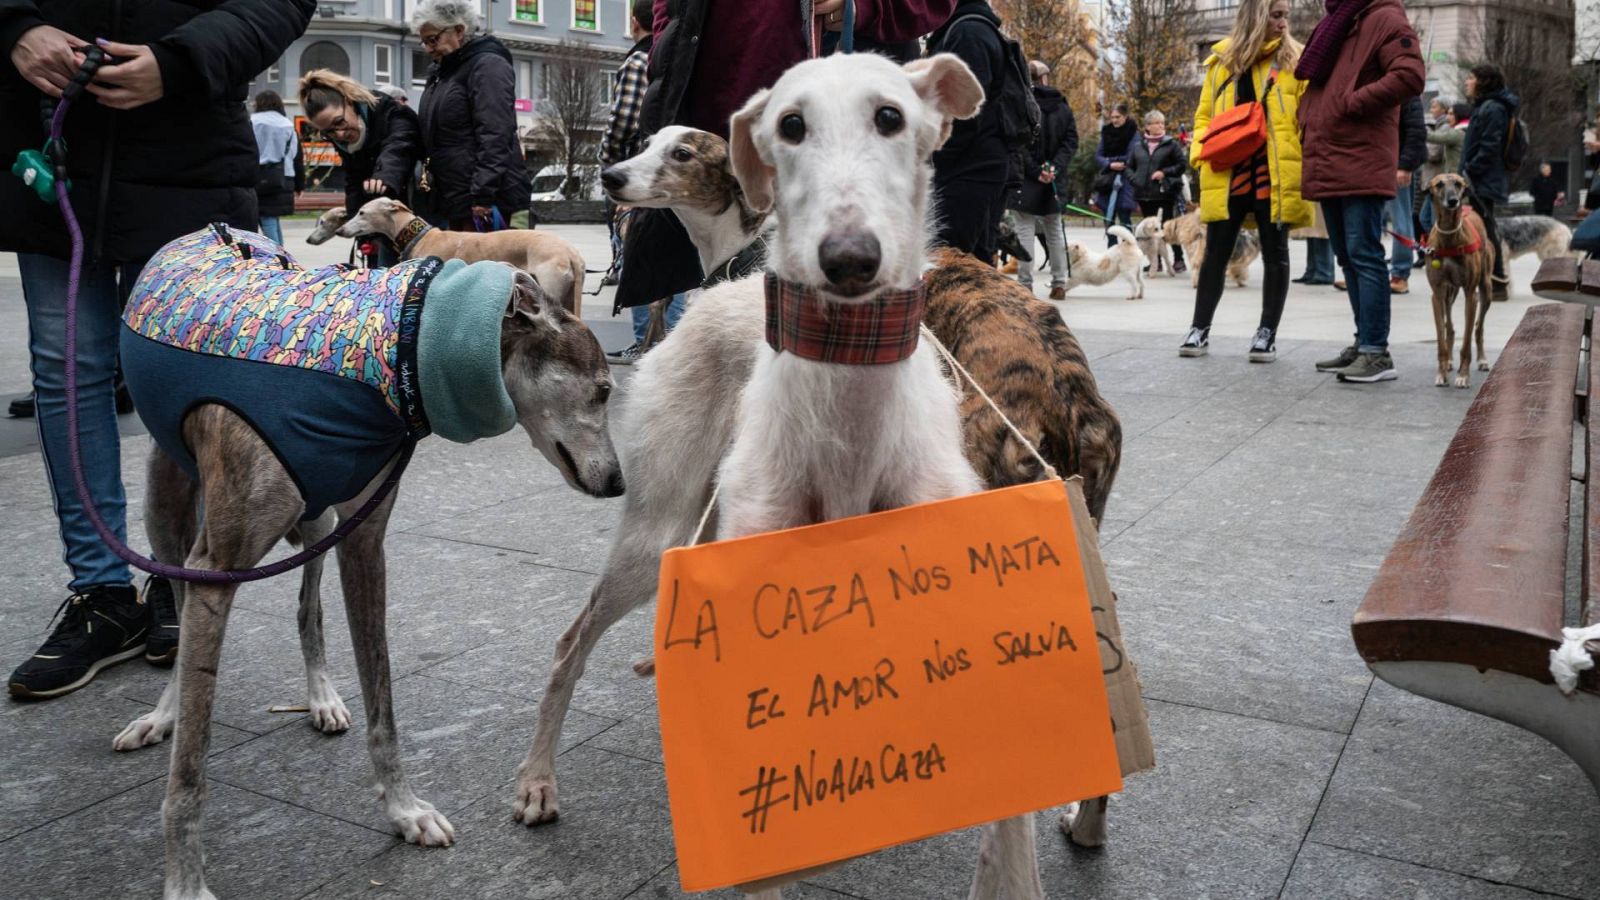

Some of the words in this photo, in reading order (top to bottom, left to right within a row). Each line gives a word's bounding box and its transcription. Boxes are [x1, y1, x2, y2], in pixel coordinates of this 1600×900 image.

[400, 361, 416, 400] adopt
[664, 578, 720, 662] LA
[752, 573, 875, 639] CAZA
[967, 536, 1061, 587] MATA
[745, 687, 785, 730] EL
[807, 658, 899, 718] AMOR
[993, 621, 1077, 666] SALVA
